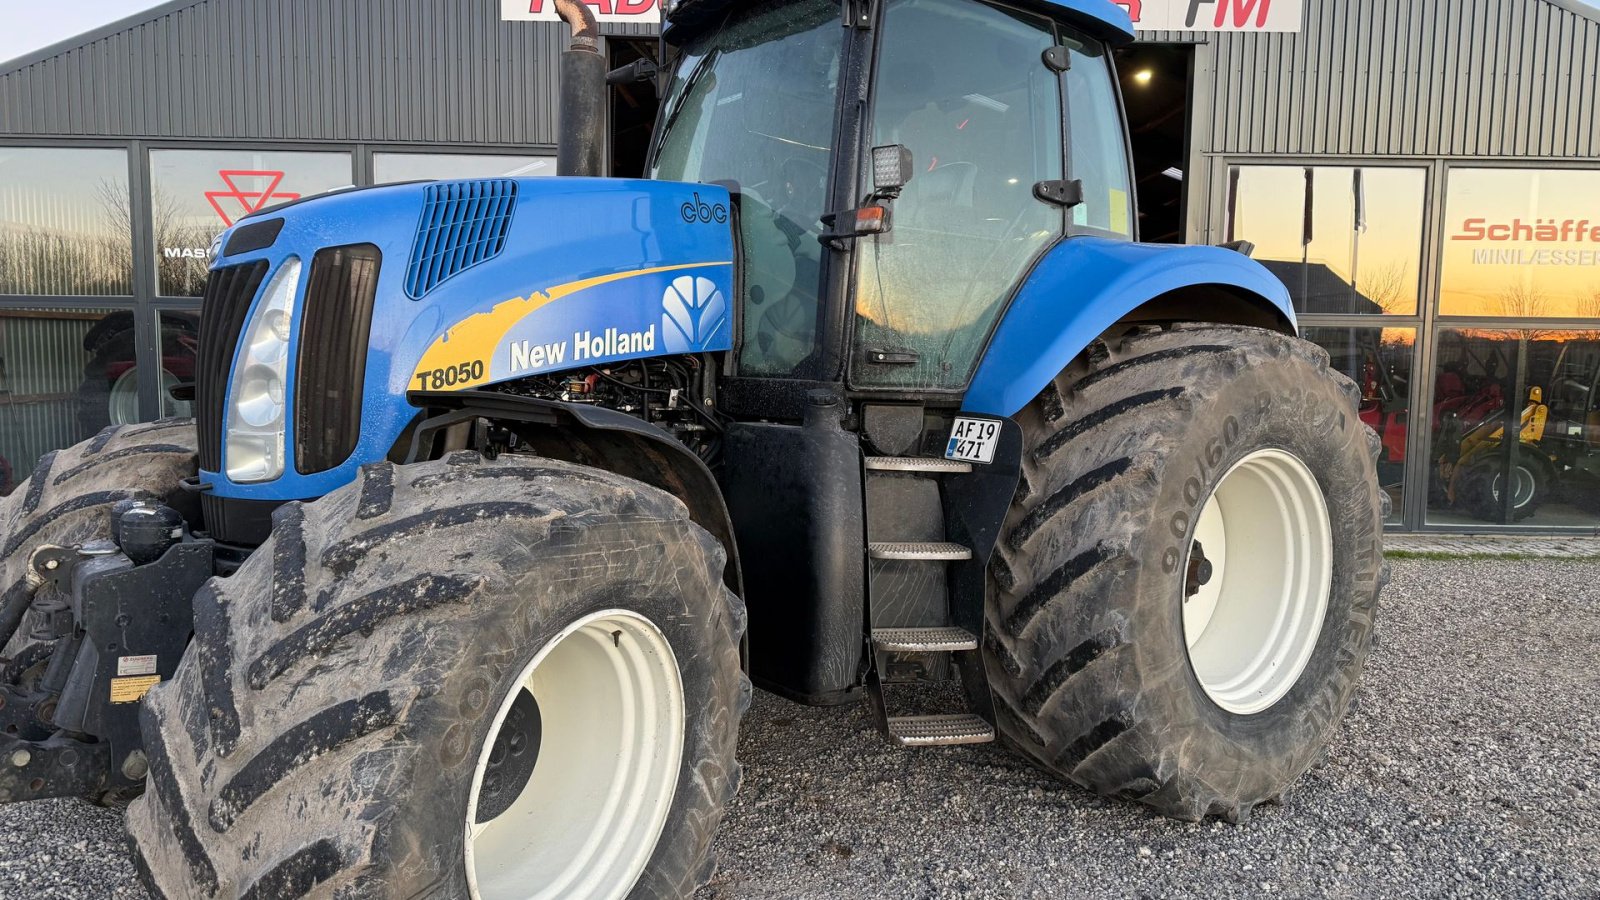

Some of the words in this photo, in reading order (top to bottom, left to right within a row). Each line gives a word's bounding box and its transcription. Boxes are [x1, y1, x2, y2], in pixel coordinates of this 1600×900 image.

[681, 192, 727, 224] cbc
[509, 338, 566, 373] New
[573, 323, 656, 361] Holland
[416, 358, 484, 392] T8050
[956, 439, 983, 459] 471
